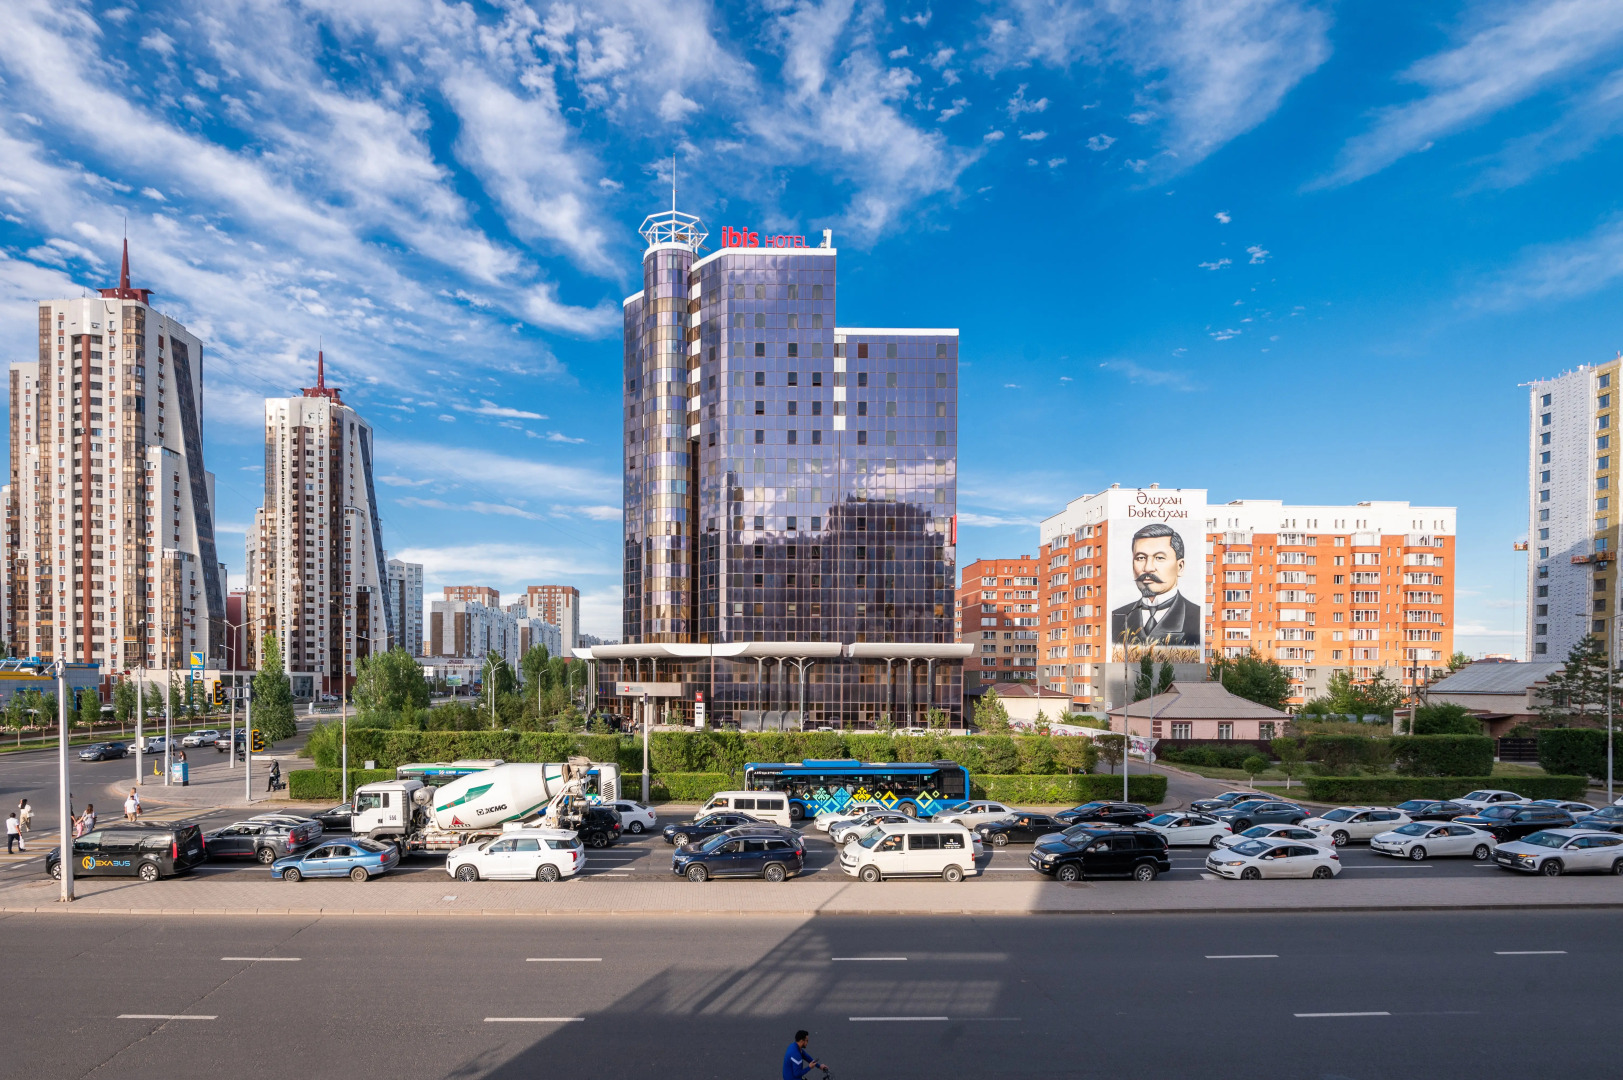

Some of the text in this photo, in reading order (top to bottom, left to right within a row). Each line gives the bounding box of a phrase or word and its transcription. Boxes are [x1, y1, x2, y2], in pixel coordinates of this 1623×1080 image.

[721, 226, 810, 248] ibis HOTEL
[485, 804, 508, 814] XCMG
